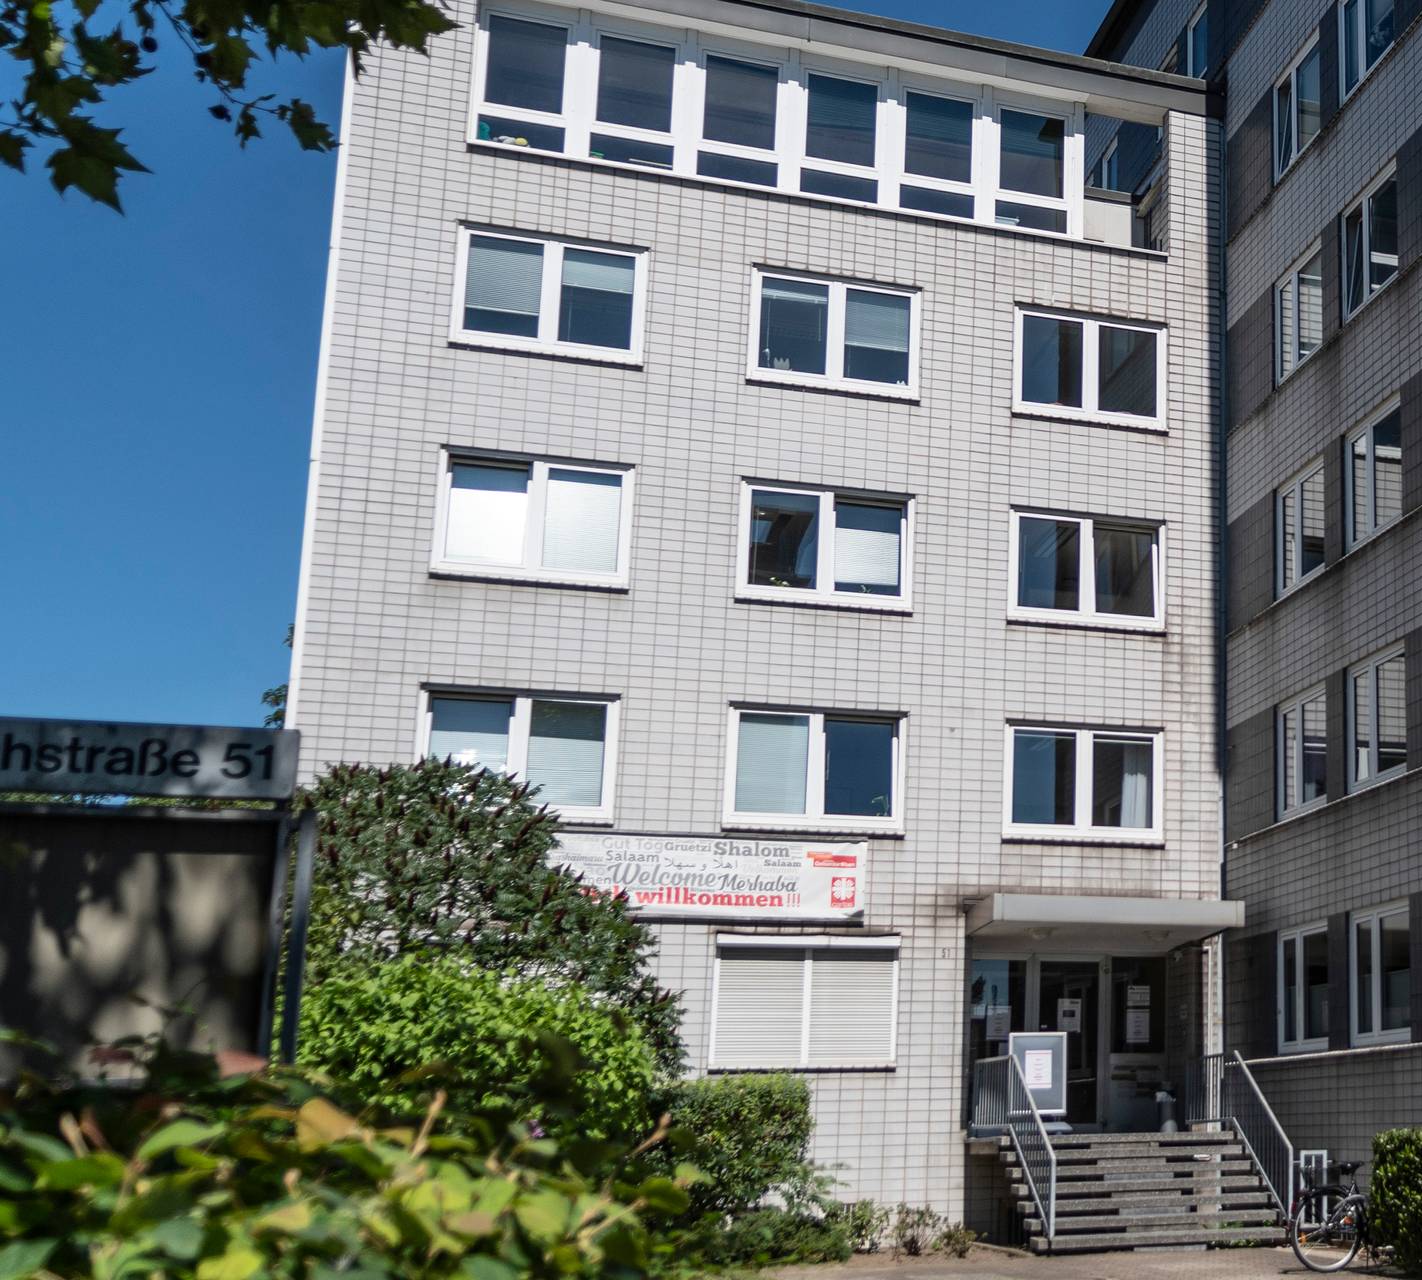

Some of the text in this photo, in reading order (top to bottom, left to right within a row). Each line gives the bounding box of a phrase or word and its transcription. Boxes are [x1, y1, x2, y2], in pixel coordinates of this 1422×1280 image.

[220, 743, 276, 780] 51
[601, 837, 630, 850] Gut
[664, 841, 712, 852] Gruetzi
[713, 841, 790, 857] Shalom
[605, 850, 660, 862] Salaam
[764, 859, 801, 867] Salaam
[607, 862, 716, 887] Welcome
[718, 874, 797, 892] Merhaba
[635, 886, 783, 907] willkommen
